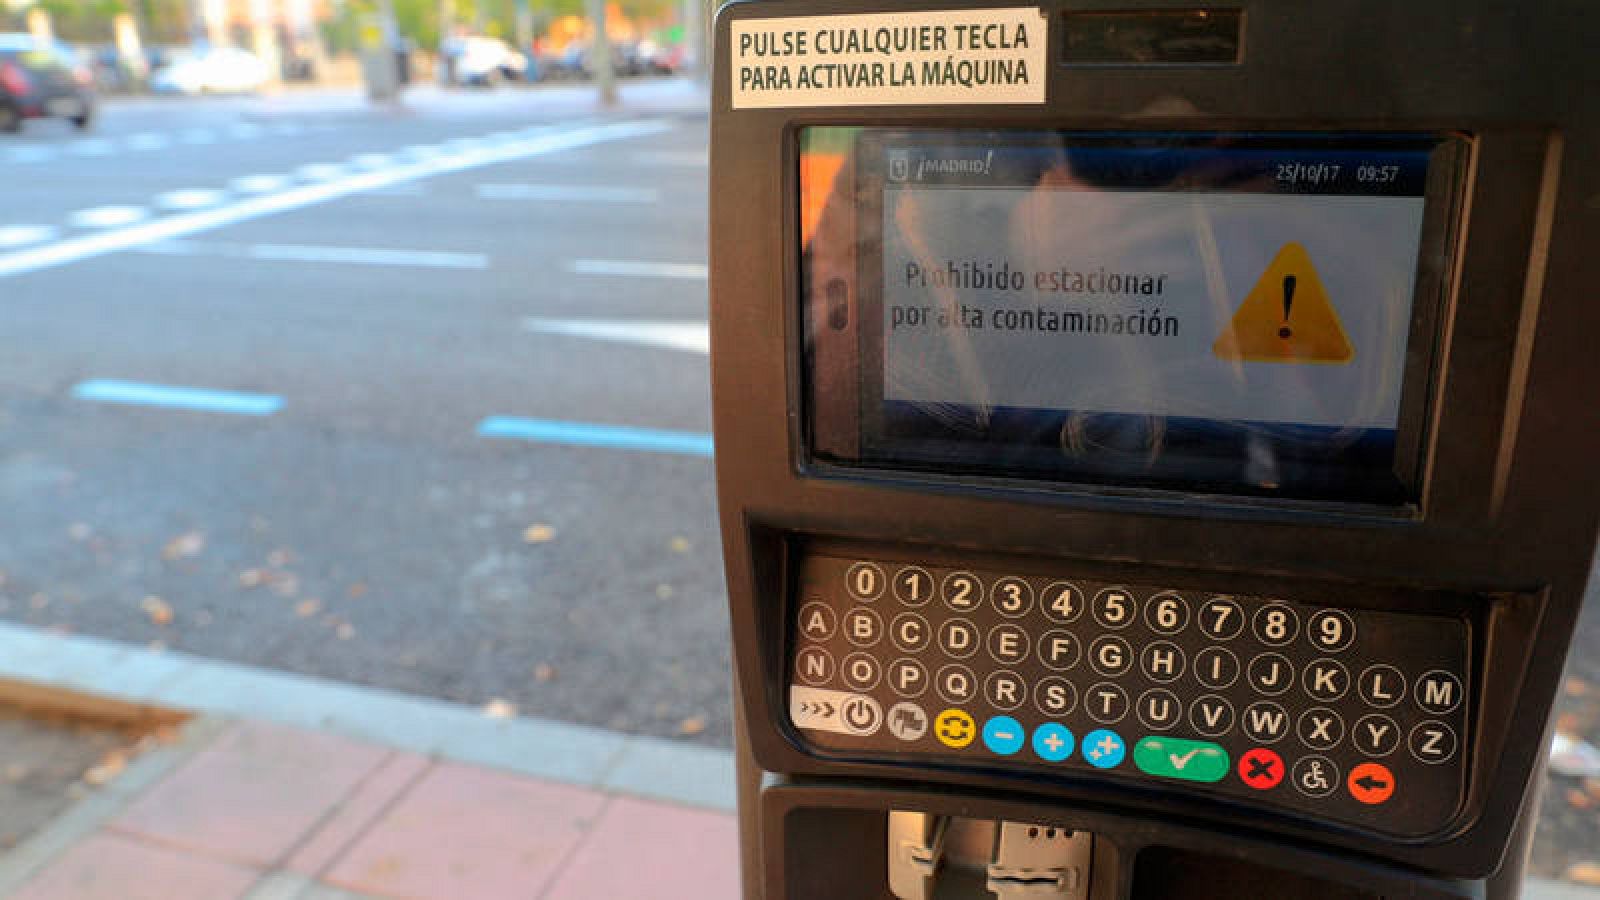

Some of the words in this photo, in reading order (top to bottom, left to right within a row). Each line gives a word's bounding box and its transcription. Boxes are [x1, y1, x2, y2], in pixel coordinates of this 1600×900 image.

[740, 31, 807, 57] PULSE
[815, 26, 948, 55] CUALQUIER
[954, 23, 1029, 49] TECLA
[740, 65, 792, 91] PARA
[797, 63, 885, 89] ACTIVAR
[890, 61, 916, 87] LA
[922, 56, 1029, 88] MÁQUINA
[1276, 163, 1340, 183] 25/10/17
[1357, 164, 1400, 182] 09:57
[905, 261, 1025, 292] Prohibido
[1033, 267, 1169, 297] estacionar
[891, 306, 928, 332] por
[938, 304, 983, 329] alta
[992, 305, 1180, 338] contaminación
[858, 568, 874, 594] 0
[906, 574, 918, 600] 1
[952, 580, 970, 606] 2
[1002, 584, 1020, 610] 3
[1052, 590, 1072, 616] 4
[1106, 594, 1124, 620] 5
[1158, 600, 1176, 626] 6
[1212, 606, 1232, 632] 7
[1266, 612, 1286, 638] 8
[1322, 617, 1342, 644] 9
[808, 612, 826, 632] A
[854, 616, 872, 638] B
[902, 622, 920, 644] C
[950, 626, 968, 648] D
[1000, 632, 1018, 656] E
[1052, 638, 1068, 660] F
[1100, 644, 1121, 666] G
[1152, 650, 1172, 674] H
[1262, 664, 1278, 684] J
[1315, 668, 1338, 692] K
[1374, 674, 1390, 698] L
[1426, 680, 1452, 704] M
[808, 656, 824, 676] N
[852, 660, 872, 682] O
[900, 666, 918, 688] P
[946, 674, 966, 696] Q
[997, 680, 1016, 702] R
[1046, 686, 1064, 708] S
[1098, 692, 1116, 714] T
[1150, 698, 1168, 720] U
[1202, 704, 1222, 726] V
[1252, 710, 1282, 734] W
[1310, 718, 1332, 740] X
[1368, 724, 1388, 746] Y
[1422, 730, 1442, 754] Z
